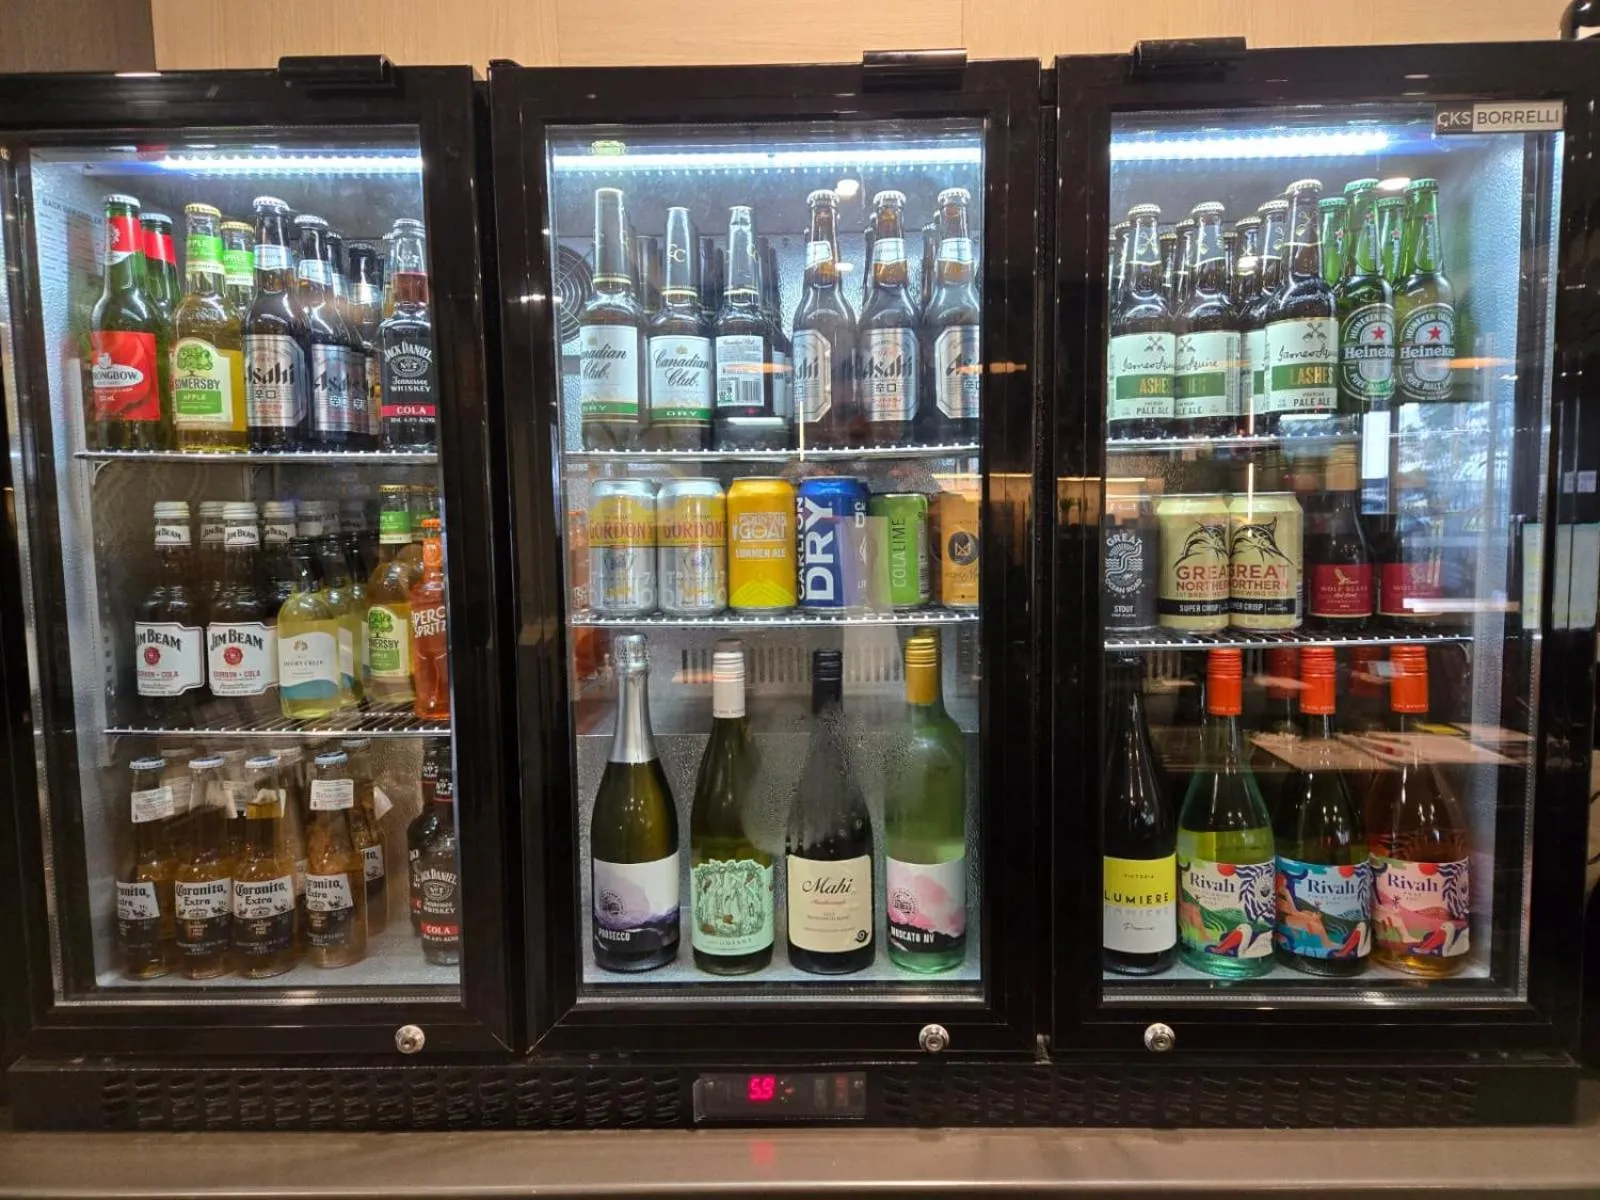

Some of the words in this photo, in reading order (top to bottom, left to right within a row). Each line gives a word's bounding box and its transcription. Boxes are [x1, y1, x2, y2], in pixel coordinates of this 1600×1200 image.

[1477, 109, 1559, 125] BORRELLI
[653, 348, 710, 369] Canadian
[1290, 365, 1334, 385] LASHES
[389, 385, 431, 393] WHISKEY
[396, 405, 427, 415] COLA
[1293, 399, 1315, 407] PALE
[1316, 398, 1332, 406] ALE
[1105, 532, 1143, 548] GREAT
[805, 496, 834, 601] DRY
[1113, 605, 1134, 613] STOUT
[146, 628, 182, 653] BEAM
[210, 632, 227, 652] JIM
[227, 628, 264, 652] BEAM
[802, 877, 853, 895] Mahi
[1190, 872, 1235, 893] Rivah
[1307, 878, 1355, 895] Rivah
[1388, 873, 1438, 893] Rivah
[184, 897, 211, 906] Extra
[245, 896, 273, 906] Extra
[426, 925, 451, 935] COLA
[923, 932, 935, 943] NV
